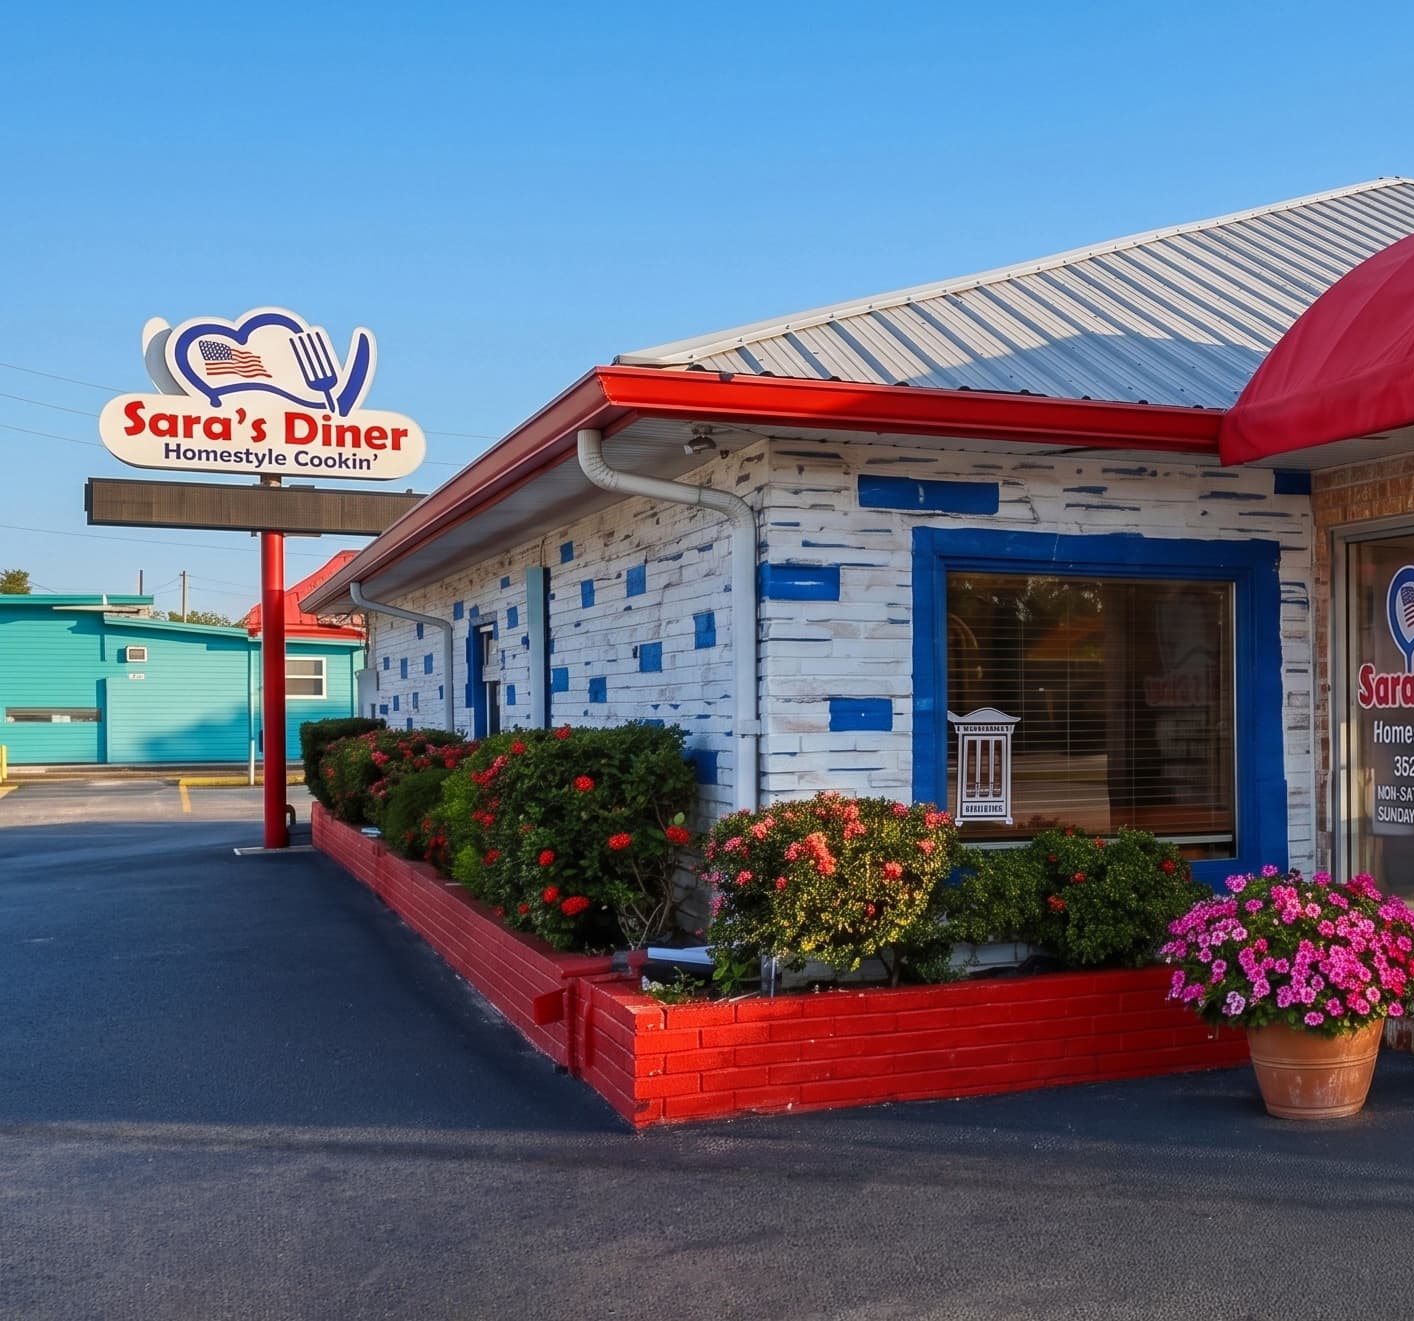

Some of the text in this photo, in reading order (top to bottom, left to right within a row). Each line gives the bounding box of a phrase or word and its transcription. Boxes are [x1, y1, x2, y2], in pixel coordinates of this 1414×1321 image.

[123, 400, 409, 451] Sara's Diner
[164, 442, 378, 471] Homestyle Cookin'
[1378, 806, 1414, 824] SUNDAY
